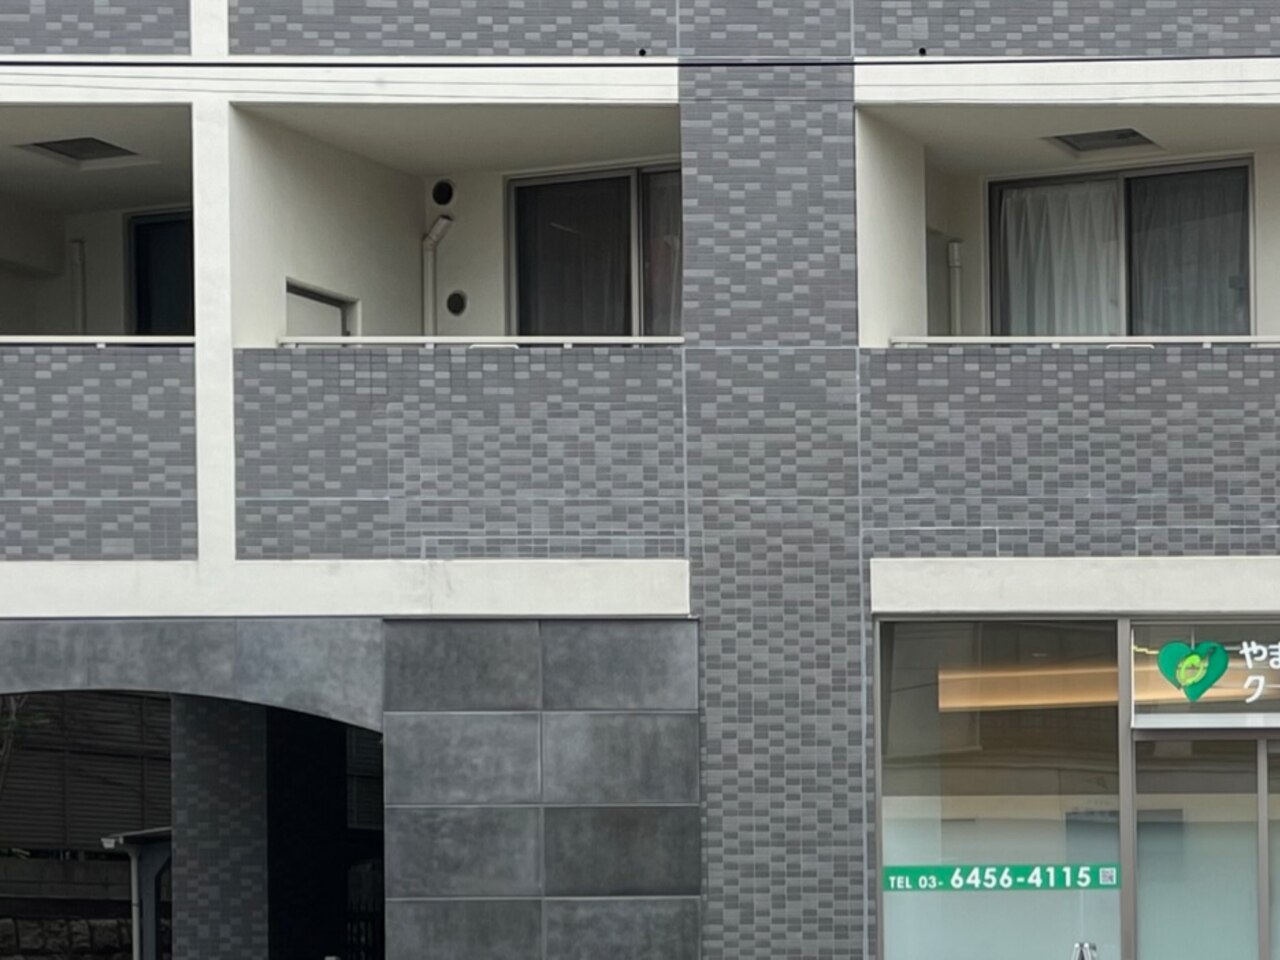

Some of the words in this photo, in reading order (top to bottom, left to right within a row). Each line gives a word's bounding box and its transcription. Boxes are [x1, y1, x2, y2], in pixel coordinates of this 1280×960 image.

[889, 876, 911, 889] TEL
[918, 876, 944, 889] 03-
[950, 867, 1092, 889] 6456-4115
